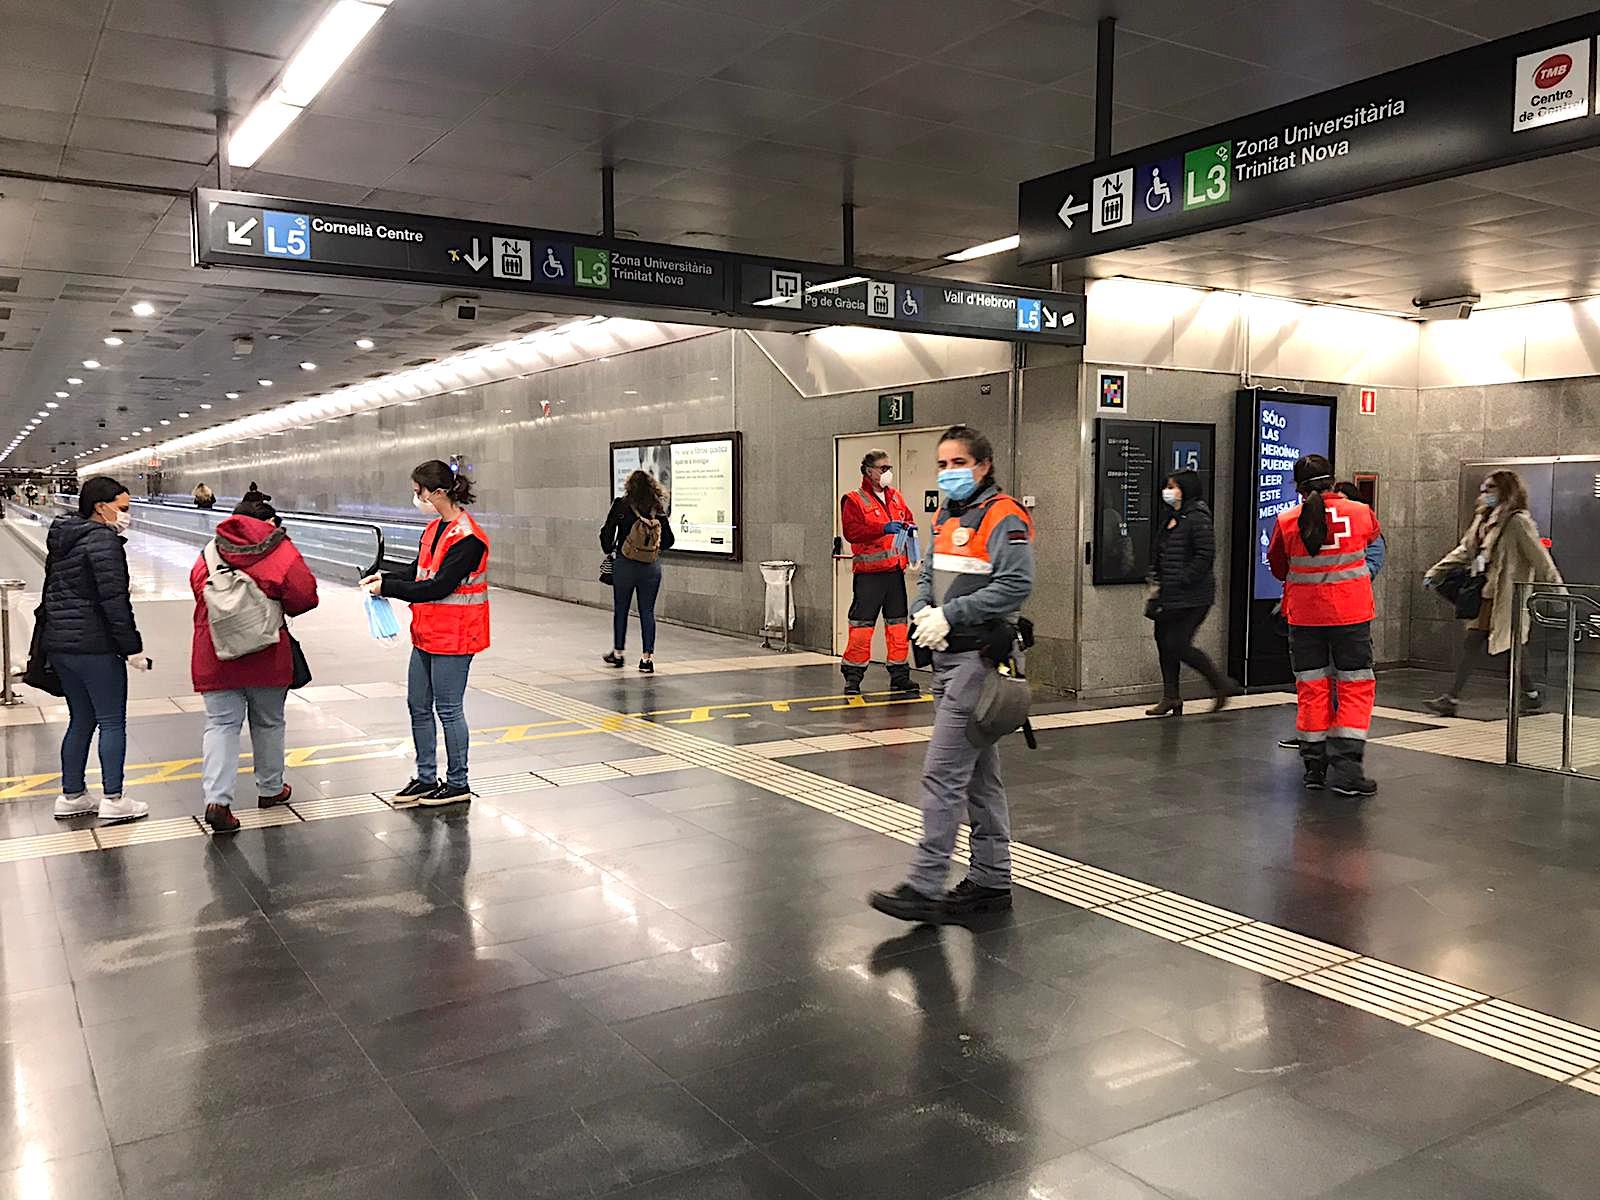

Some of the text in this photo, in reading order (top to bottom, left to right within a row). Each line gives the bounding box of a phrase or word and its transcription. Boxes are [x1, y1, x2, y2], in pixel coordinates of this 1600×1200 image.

[1540, 64, 1568, 79] TMB
[1531, 89, 1573, 107] Centre
[1519, 111, 1534, 123] de
[1235, 98, 1405, 159] Zona Universitària
[1235, 140, 1349, 182] Trinitat Nova
[1187, 164, 1227, 206] L3
[266, 217, 424, 256] L5 Cornellà Centre
[577, 252, 713, 286] L3 Zona Universitària
[611, 266, 684, 286] Trinitat Nova
[804, 294, 866, 311] Pg de Gràcia
[944, 289, 1039, 329] Vall d'Hebron L5
[1262, 409, 1287, 429] SÓLO
[1261, 426, 1280, 442] LAS
[1261, 442, 1300, 459] HEROÍNAS
[1260, 458, 1294, 471] PUEDEN
[1260, 474, 1282, 487] LEER
[1259, 489, 1281, 502] ESTE
